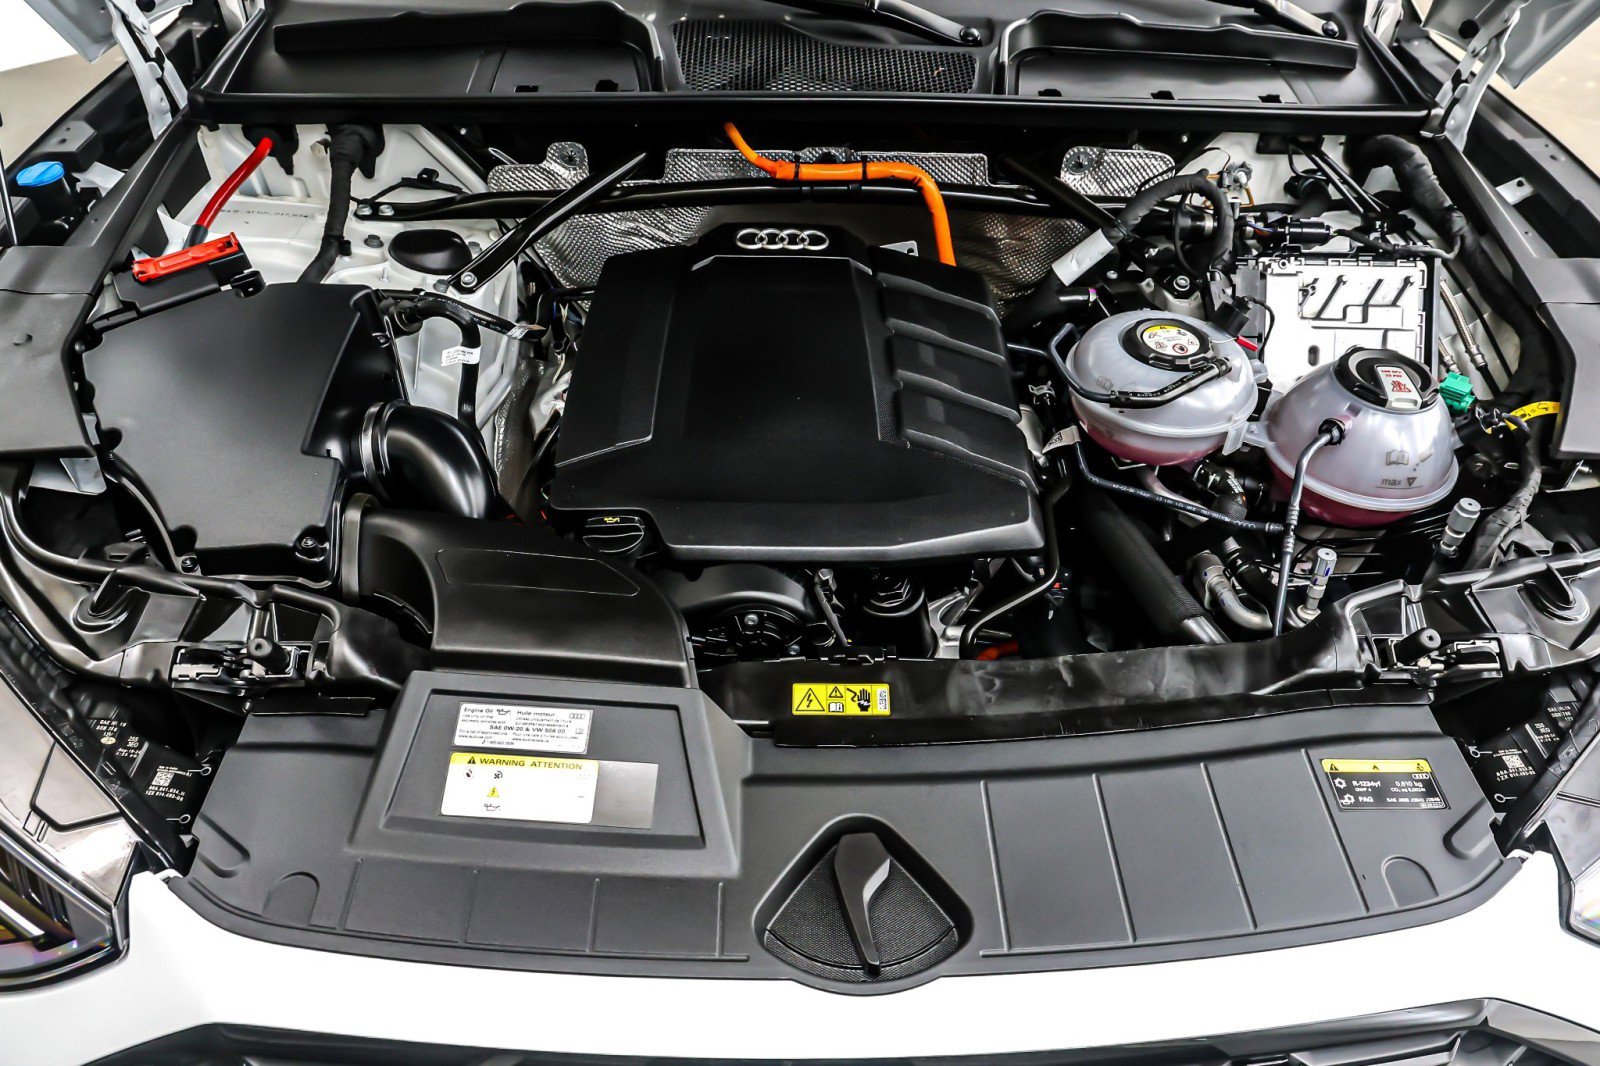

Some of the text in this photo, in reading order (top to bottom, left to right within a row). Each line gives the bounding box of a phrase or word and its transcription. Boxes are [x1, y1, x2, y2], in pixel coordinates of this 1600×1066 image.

[1381, 478, 1402, 486] max
[479, 757, 582, 770] WARNING ATTENTION
[1352, 780, 1381, 788] R-1234yf
[1413, 780, 1424, 788] kg
